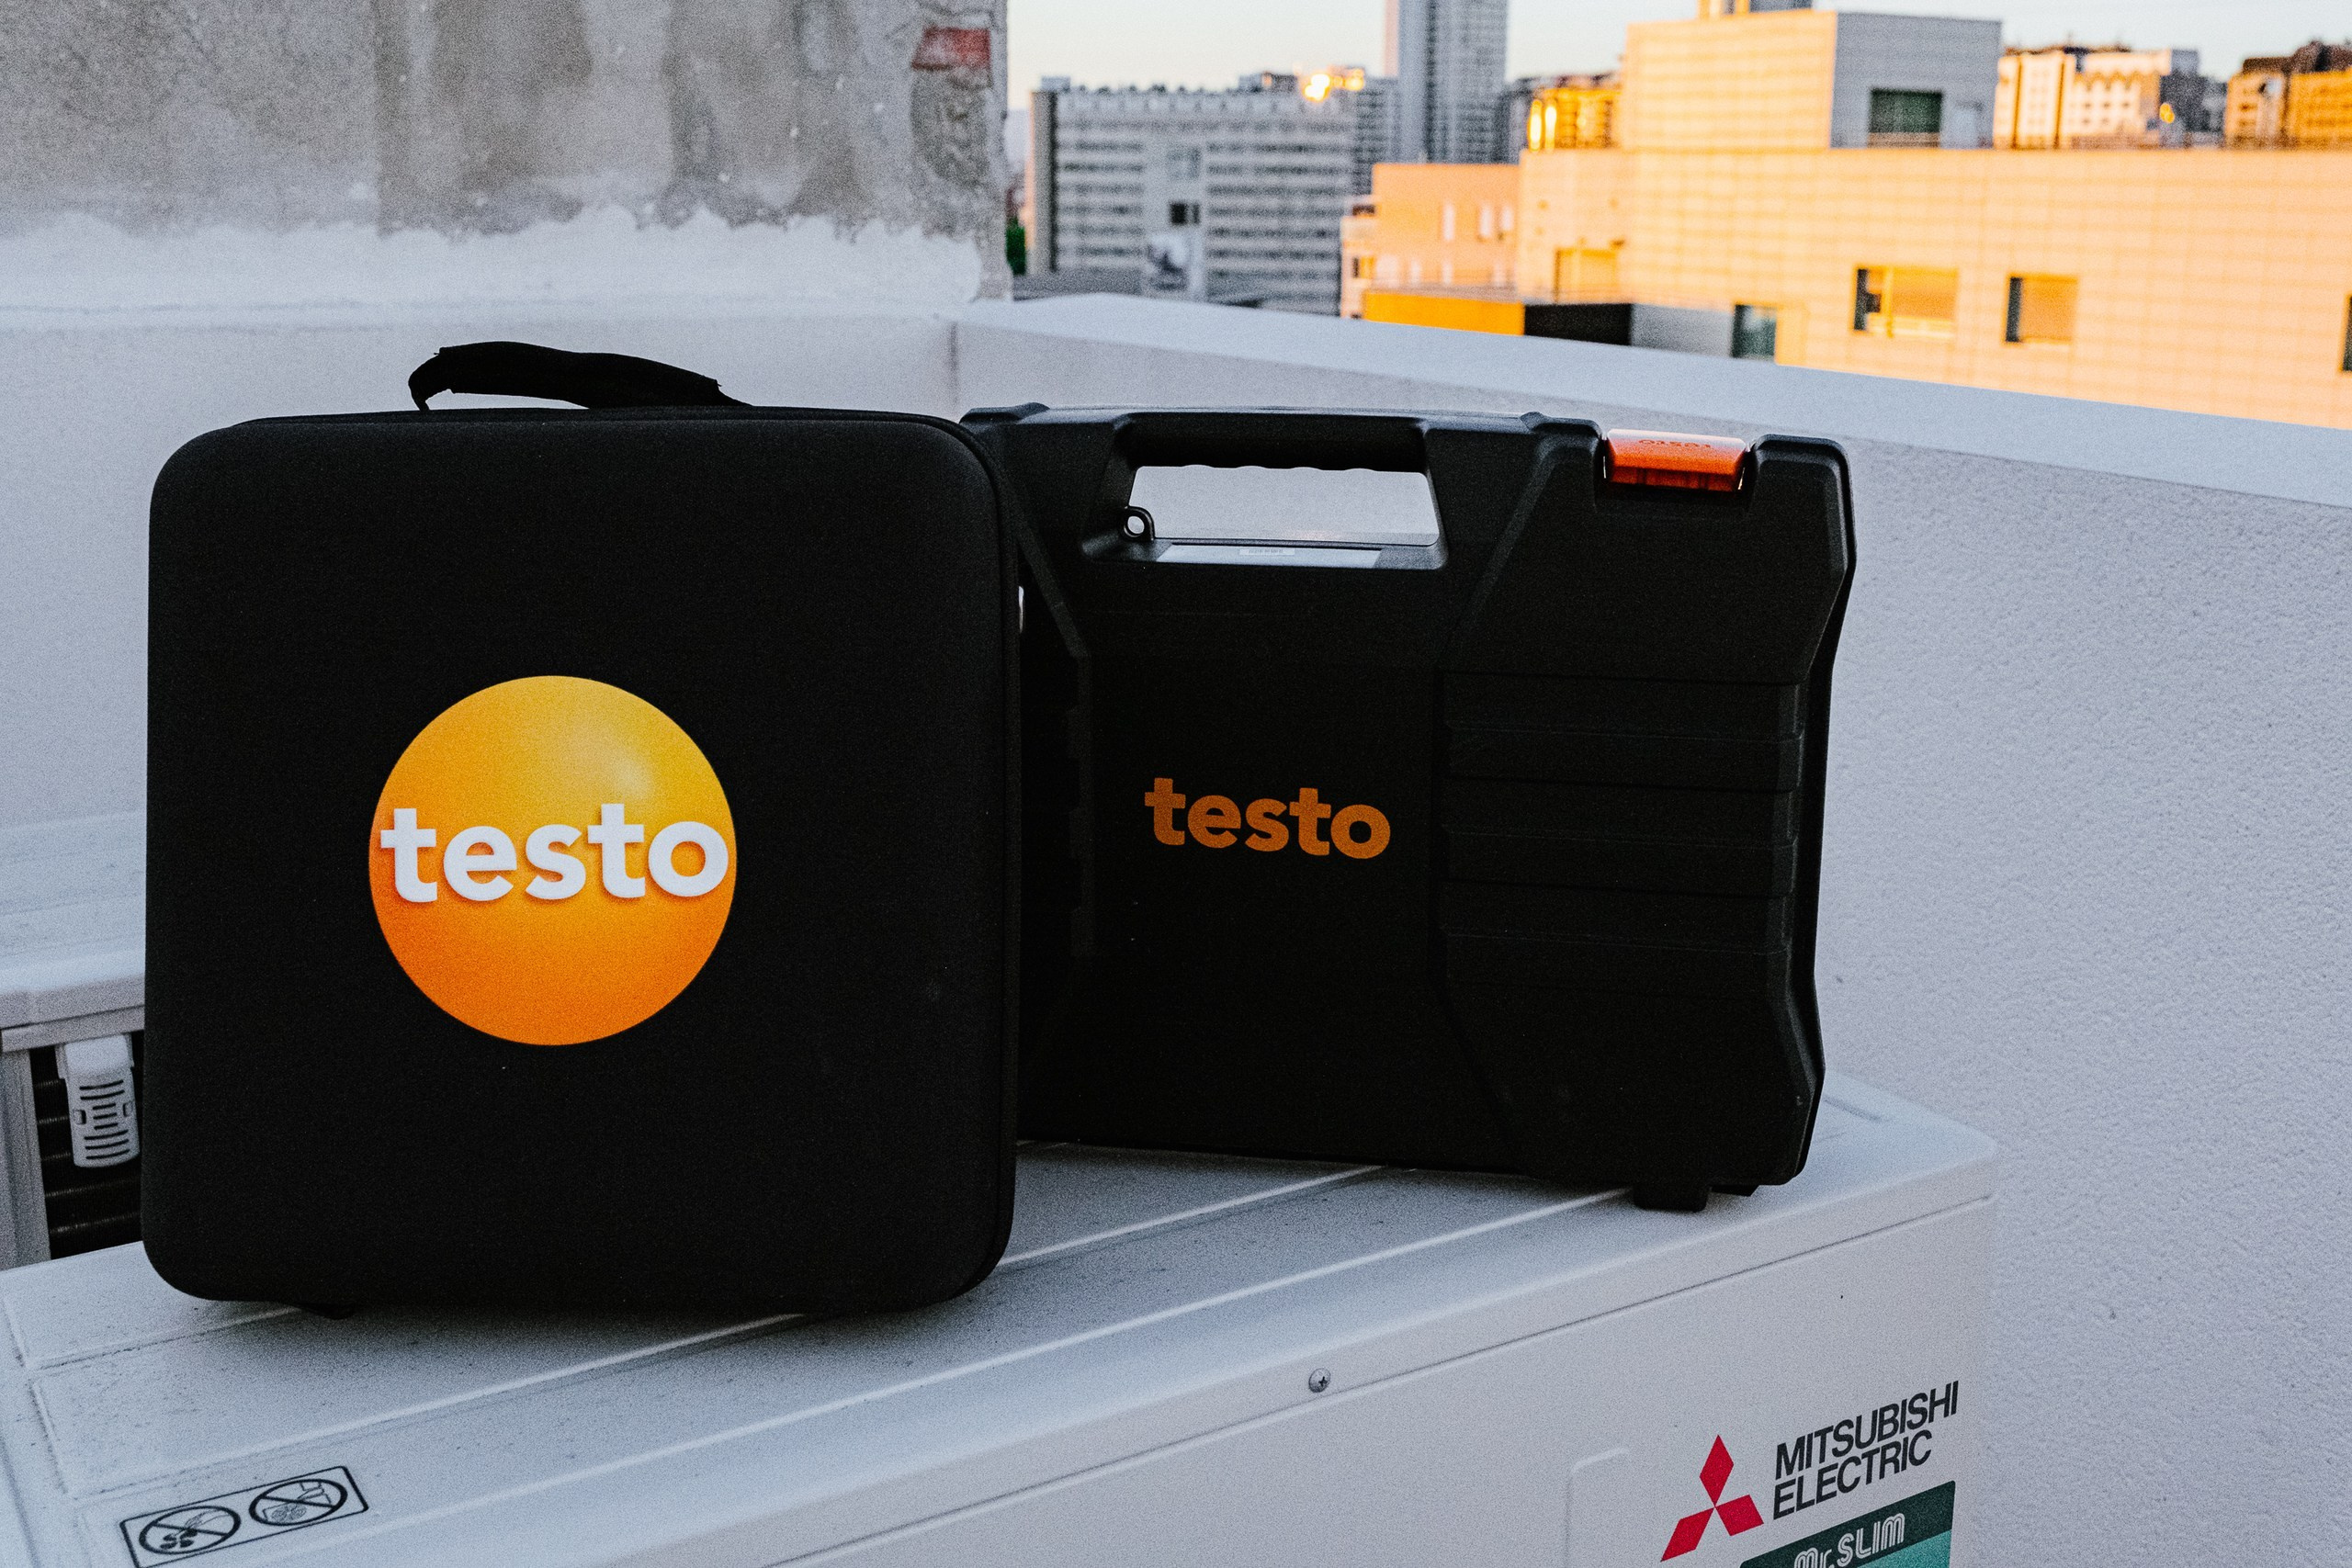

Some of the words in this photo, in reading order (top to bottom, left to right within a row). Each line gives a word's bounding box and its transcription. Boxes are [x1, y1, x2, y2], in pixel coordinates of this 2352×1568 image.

[380, 803, 729, 902] testo
[1145, 777, 1391, 859] testo
[1773, 1429, 1932, 1520] ELECTRIC
[1775, 1380, 1959, 1481] MITSUBISHI
